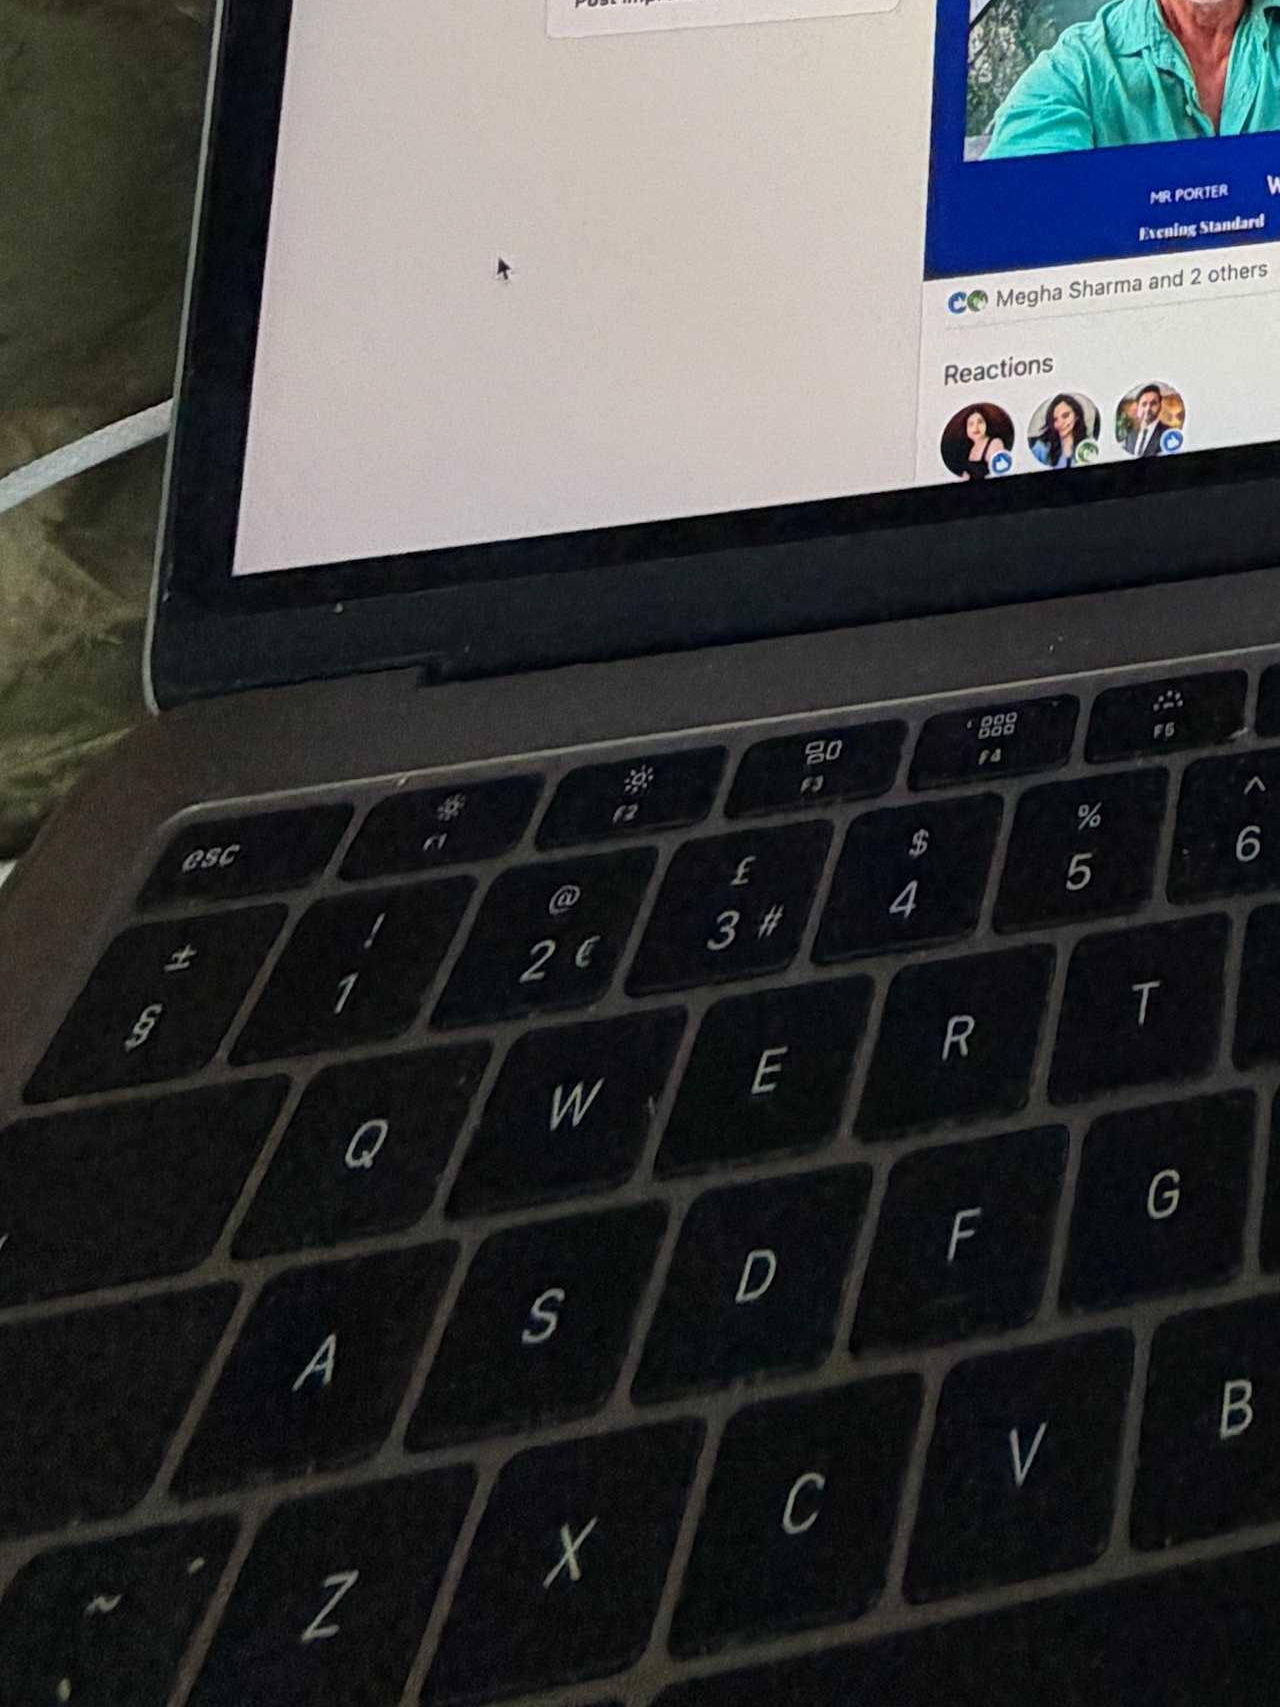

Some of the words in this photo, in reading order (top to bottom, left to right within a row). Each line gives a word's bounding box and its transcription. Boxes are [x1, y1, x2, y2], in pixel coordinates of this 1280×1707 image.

[1139, 222, 1197, 243] Evening
[1199, 212, 1266, 235] Standard
[996, 285, 1064, 311] Megha
[1068, 274, 1144, 301] Sharma
[1148, 269, 1185, 291] and
[1189, 268, 1203, 286] 2
[1207, 259, 1269, 283] others
[943, 353, 1055, 386] Reactions
[182, 842, 241, 872] esc
[1132, 981, 1160, 1025] T
[550, 1078, 606, 1130] W
[1147, 1169, 1181, 1219] G
